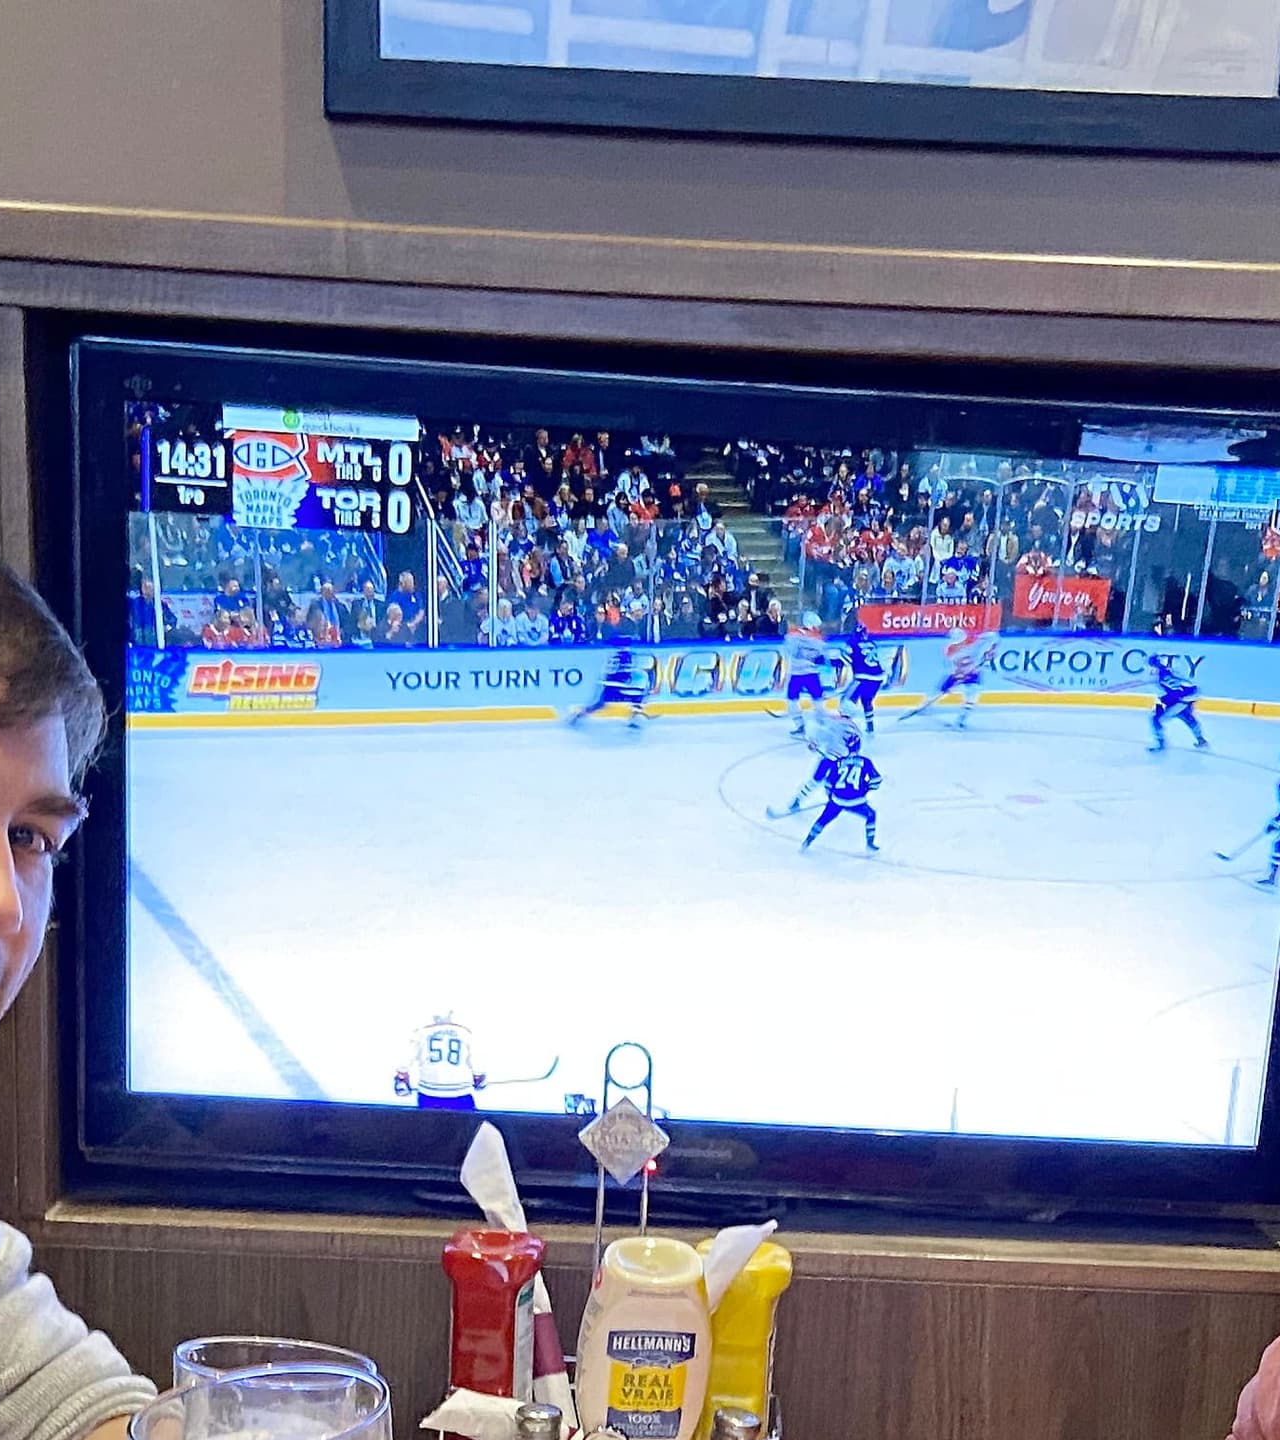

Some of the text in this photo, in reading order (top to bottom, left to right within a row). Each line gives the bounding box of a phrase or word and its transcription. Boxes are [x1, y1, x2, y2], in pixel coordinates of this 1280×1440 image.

[156, 439, 227, 479] 14:31
[317, 442, 412, 485] MTL 0
[237, 487, 292, 508] TORONTO
[316, 487, 411, 533] TOR 0
[1071, 510, 1161, 533] SPORTS
[882, 611, 977, 630] Scotia Perks
[190, 660, 321, 694] RISING
[977, 649, 1206, 679] ACKPOT CTY
[386, 667, 583, 691] YOUR TURN TO
[427, 1036, 462, 1066] 58
[621, 1387, 674, 1400] VRAIE
[623, 1373, 672, 1388] REAL
